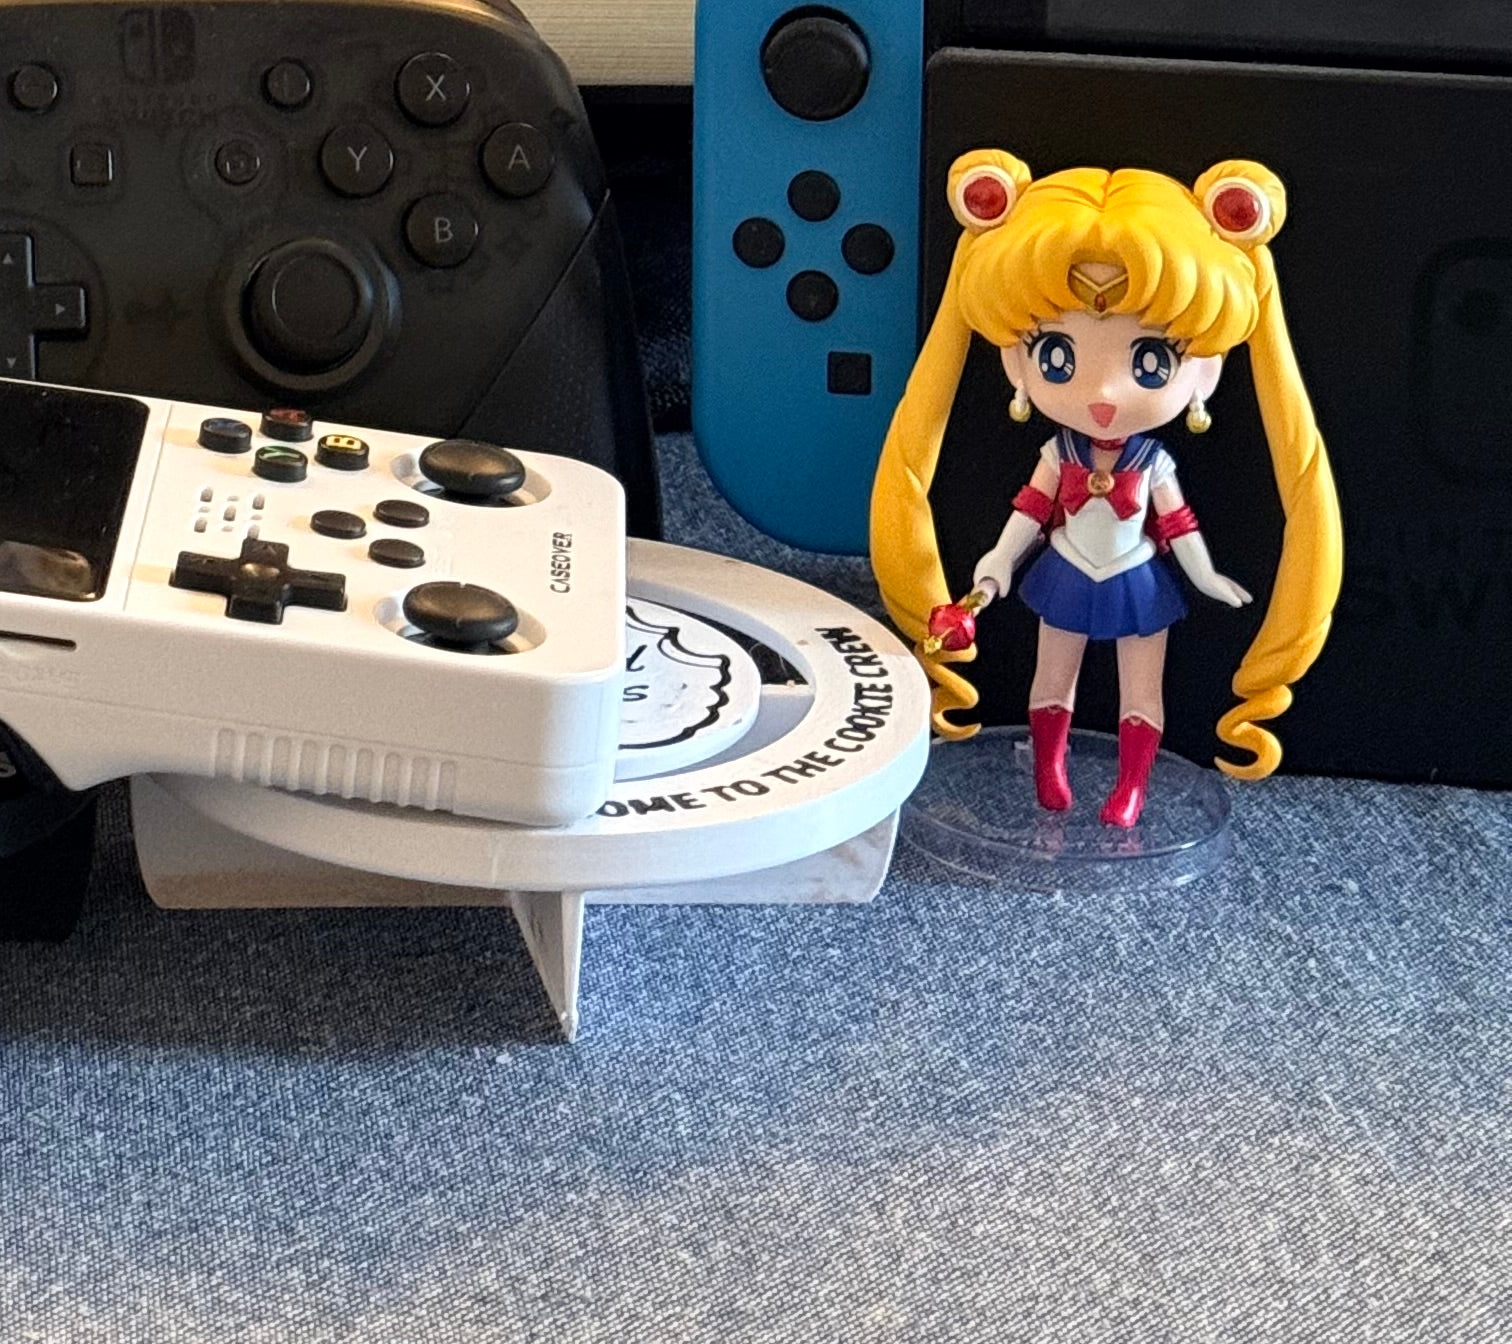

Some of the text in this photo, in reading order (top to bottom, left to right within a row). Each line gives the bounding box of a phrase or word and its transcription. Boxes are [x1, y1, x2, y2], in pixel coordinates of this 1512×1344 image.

[425, 74, 448, 102] X
[345, 146, 369, 172] Y
[506, 144, 531, 170] A
[433, 216, 453, 243] B
[814, 626, 888, 679] CREW
[824, 682, 893, 753] COOKIE
[761, 750, 846, 786] THE
[701, 780, 771, 802] TO
